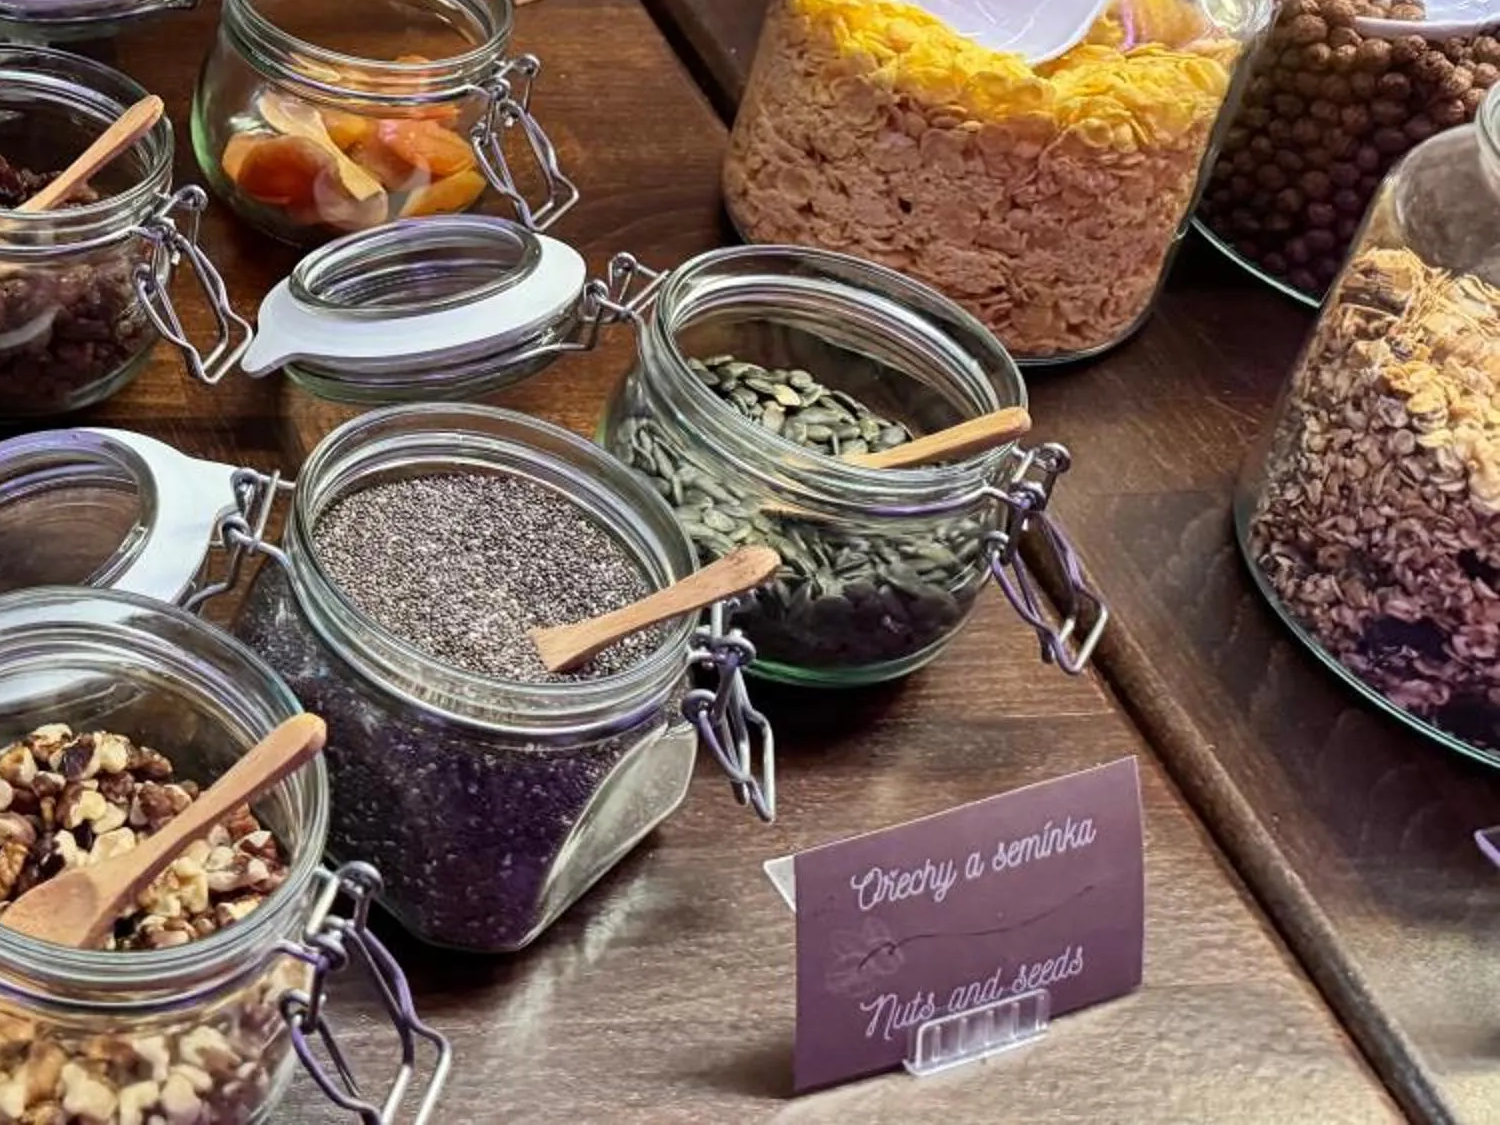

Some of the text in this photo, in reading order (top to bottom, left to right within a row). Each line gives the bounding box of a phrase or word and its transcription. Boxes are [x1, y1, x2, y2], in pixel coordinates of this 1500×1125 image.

[850, 816, 1097, 911] Ořechy a semínka
[859, 945, 1084, 1040] Nuts and seeds
